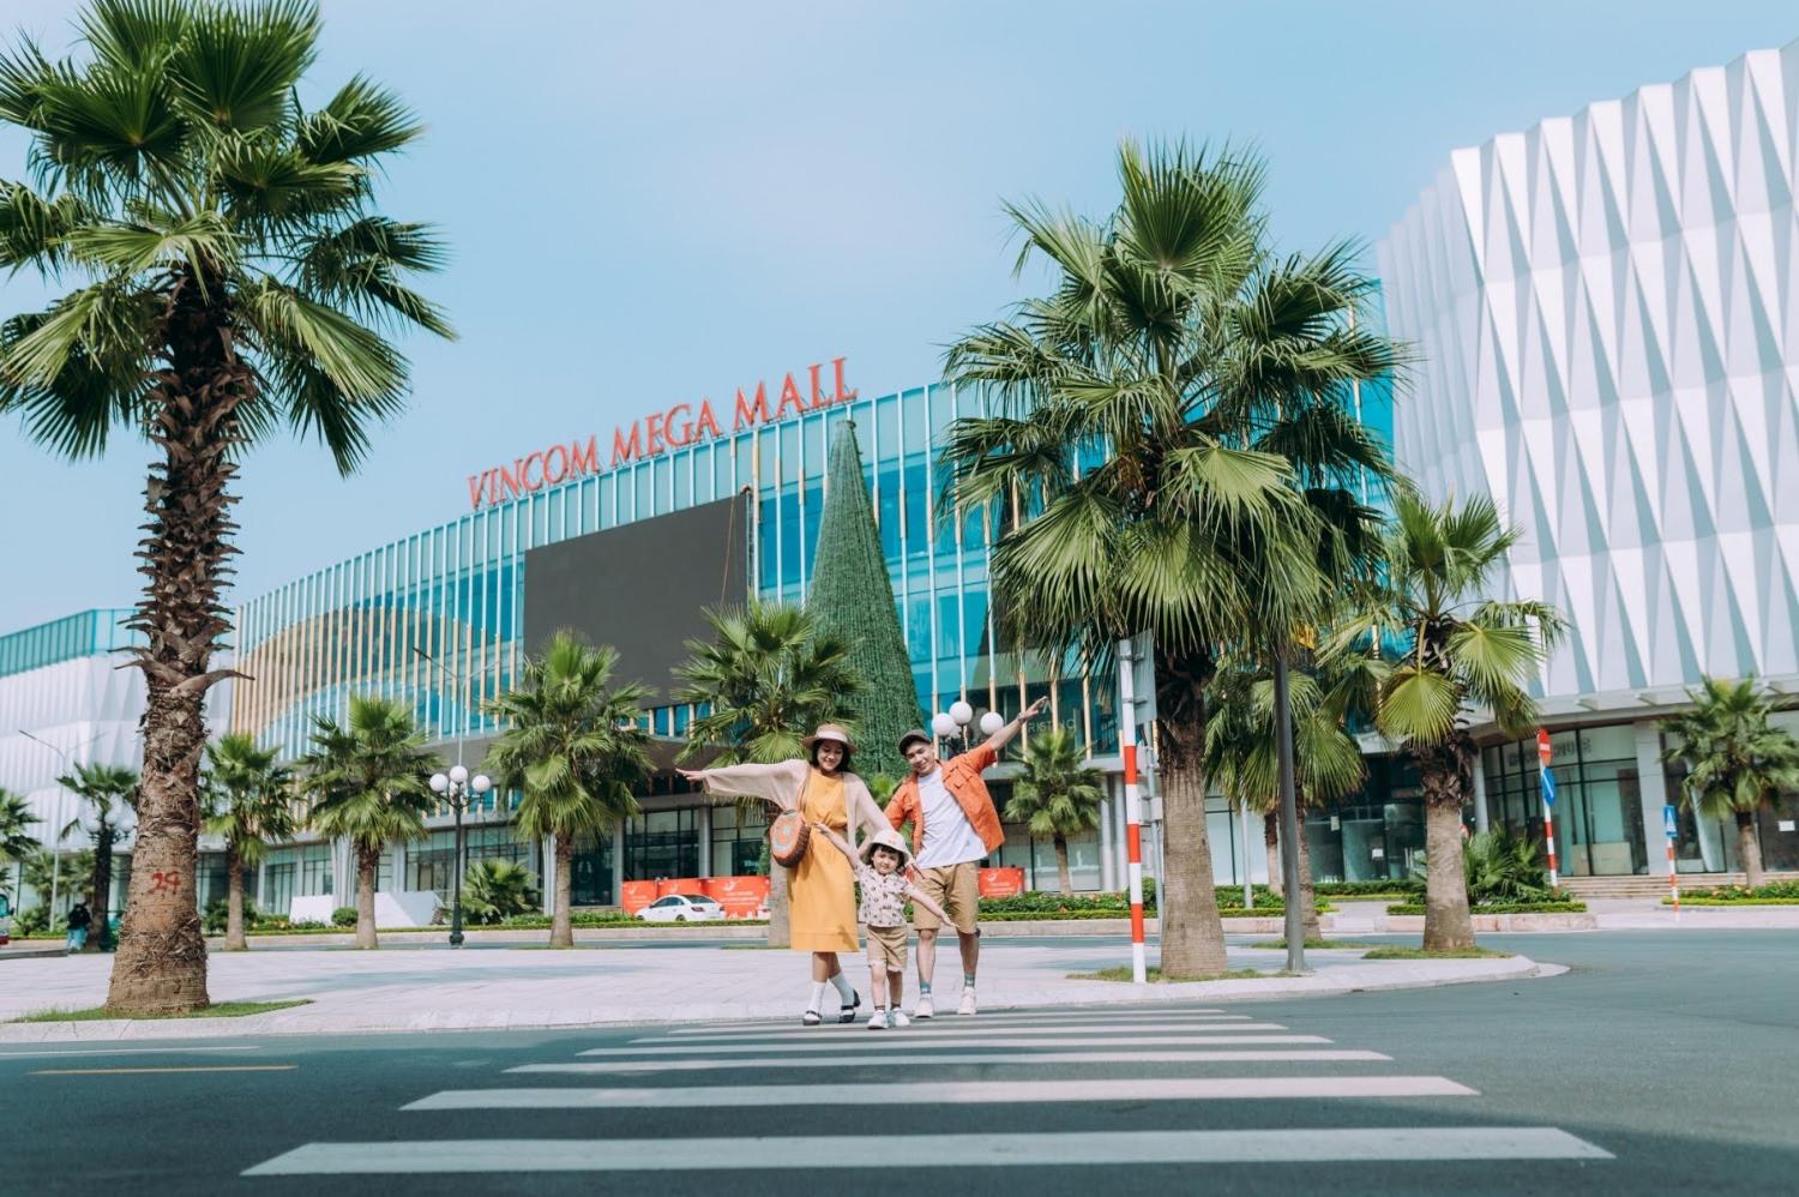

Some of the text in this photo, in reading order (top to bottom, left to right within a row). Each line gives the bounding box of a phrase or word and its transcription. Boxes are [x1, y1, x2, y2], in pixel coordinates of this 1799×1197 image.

[467, 356, 859, 511] VINCOM MEGA MALL
[1028, 719, 1074, 733] RISTO
